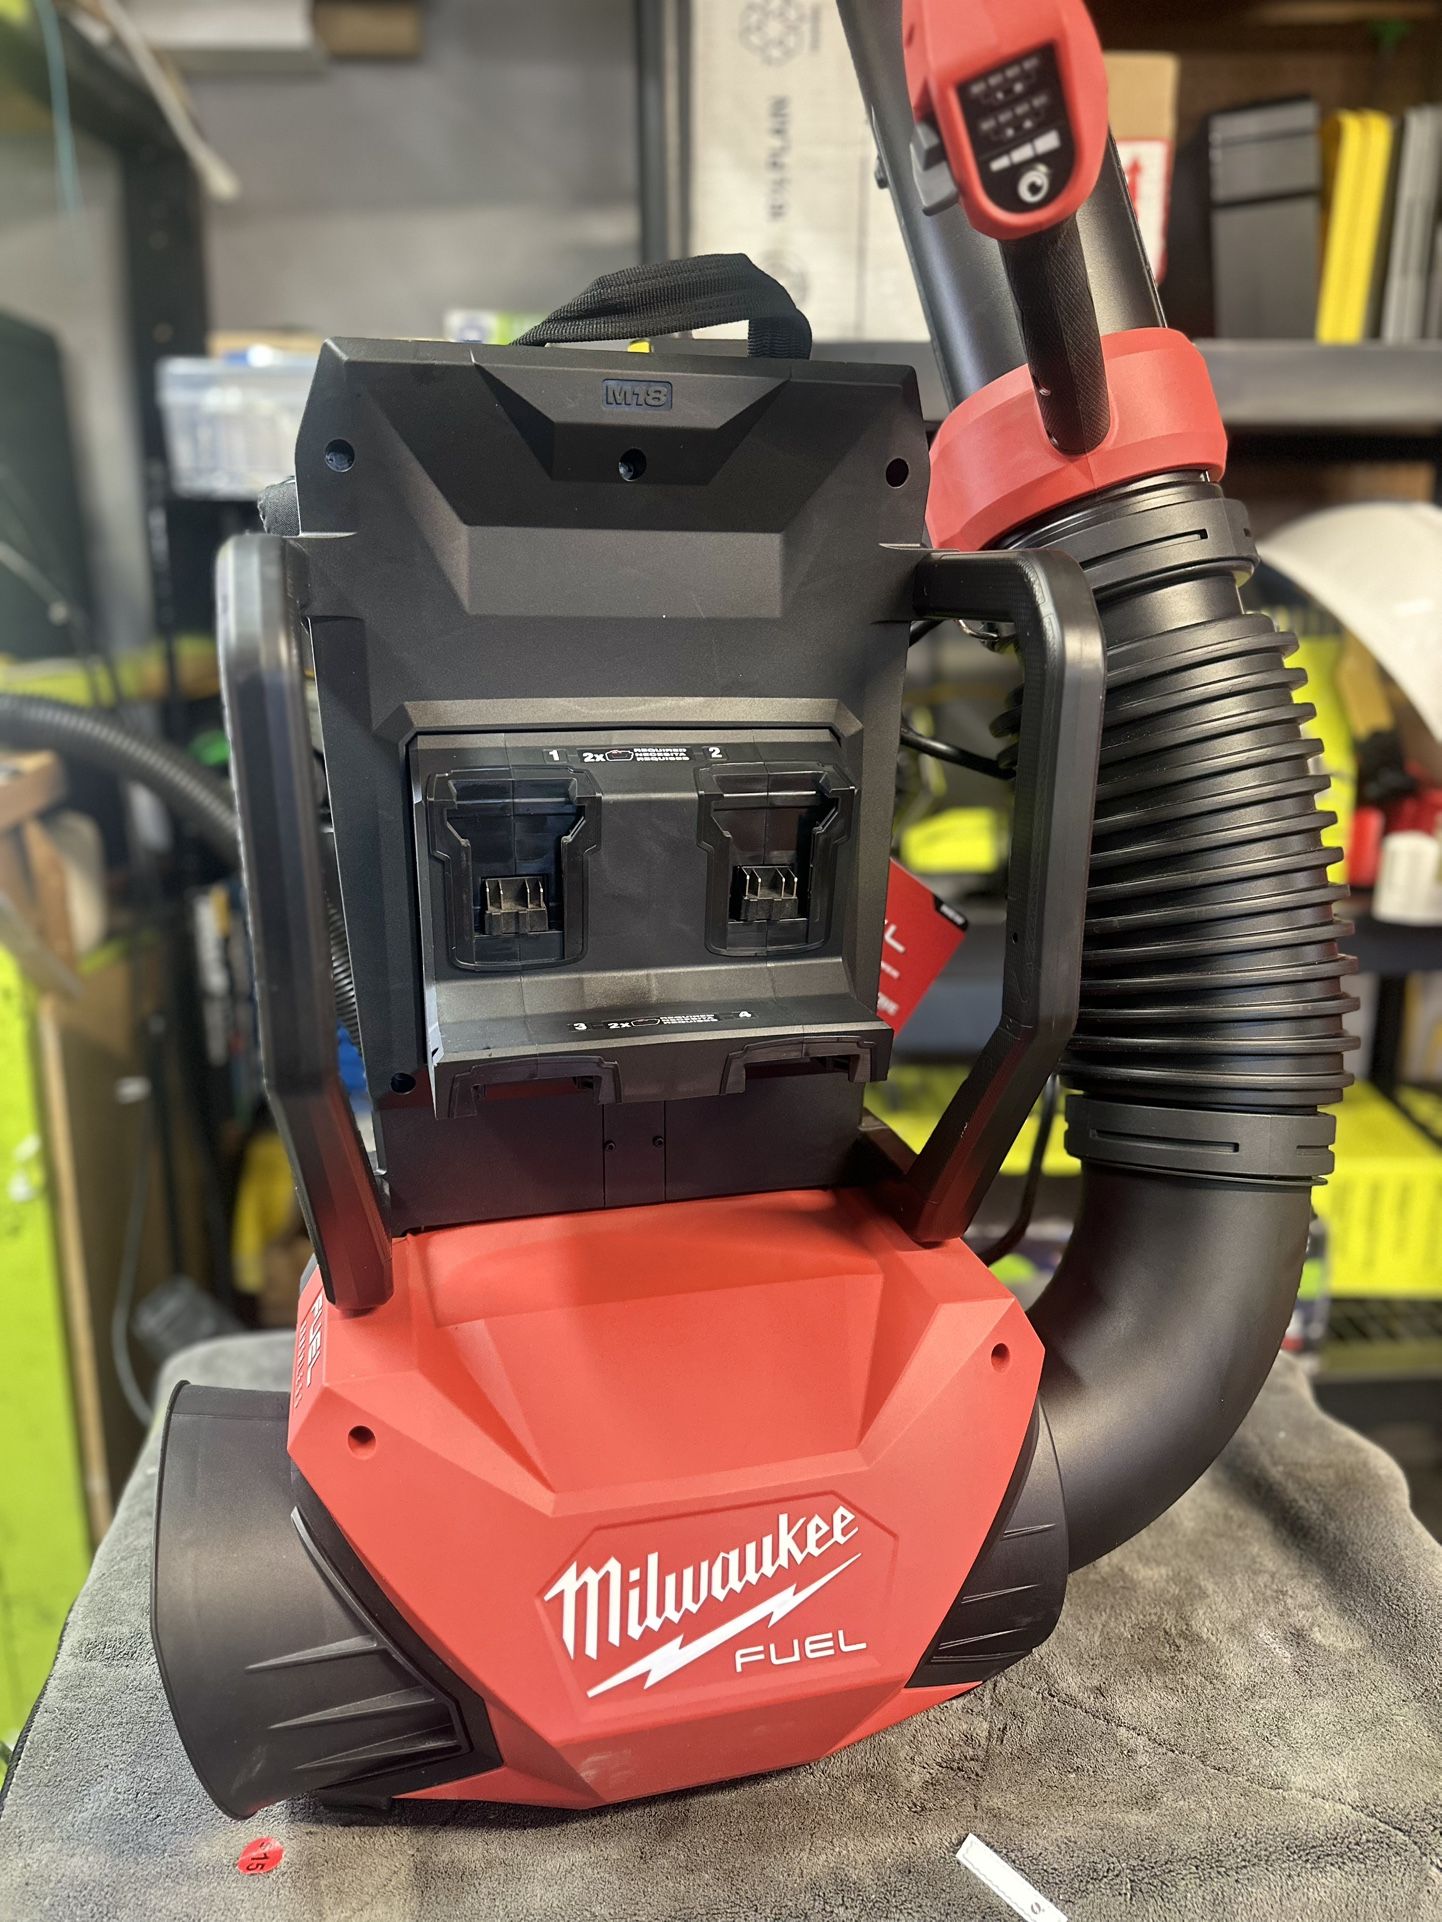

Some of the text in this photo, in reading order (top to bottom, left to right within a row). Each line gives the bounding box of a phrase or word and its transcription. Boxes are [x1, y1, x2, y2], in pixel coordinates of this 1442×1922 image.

[606, 385, 668, 408] M18
[549, 749, 560, 761] 1
[708, 746, 723, 758] 2
[573, 1022, 588, 1031] 3
[307, 1293, 323, 1388] FUEL
[543, 1505, 860, 1661] Milwaukee
[734, 1629, 868, 1673] FUEL
